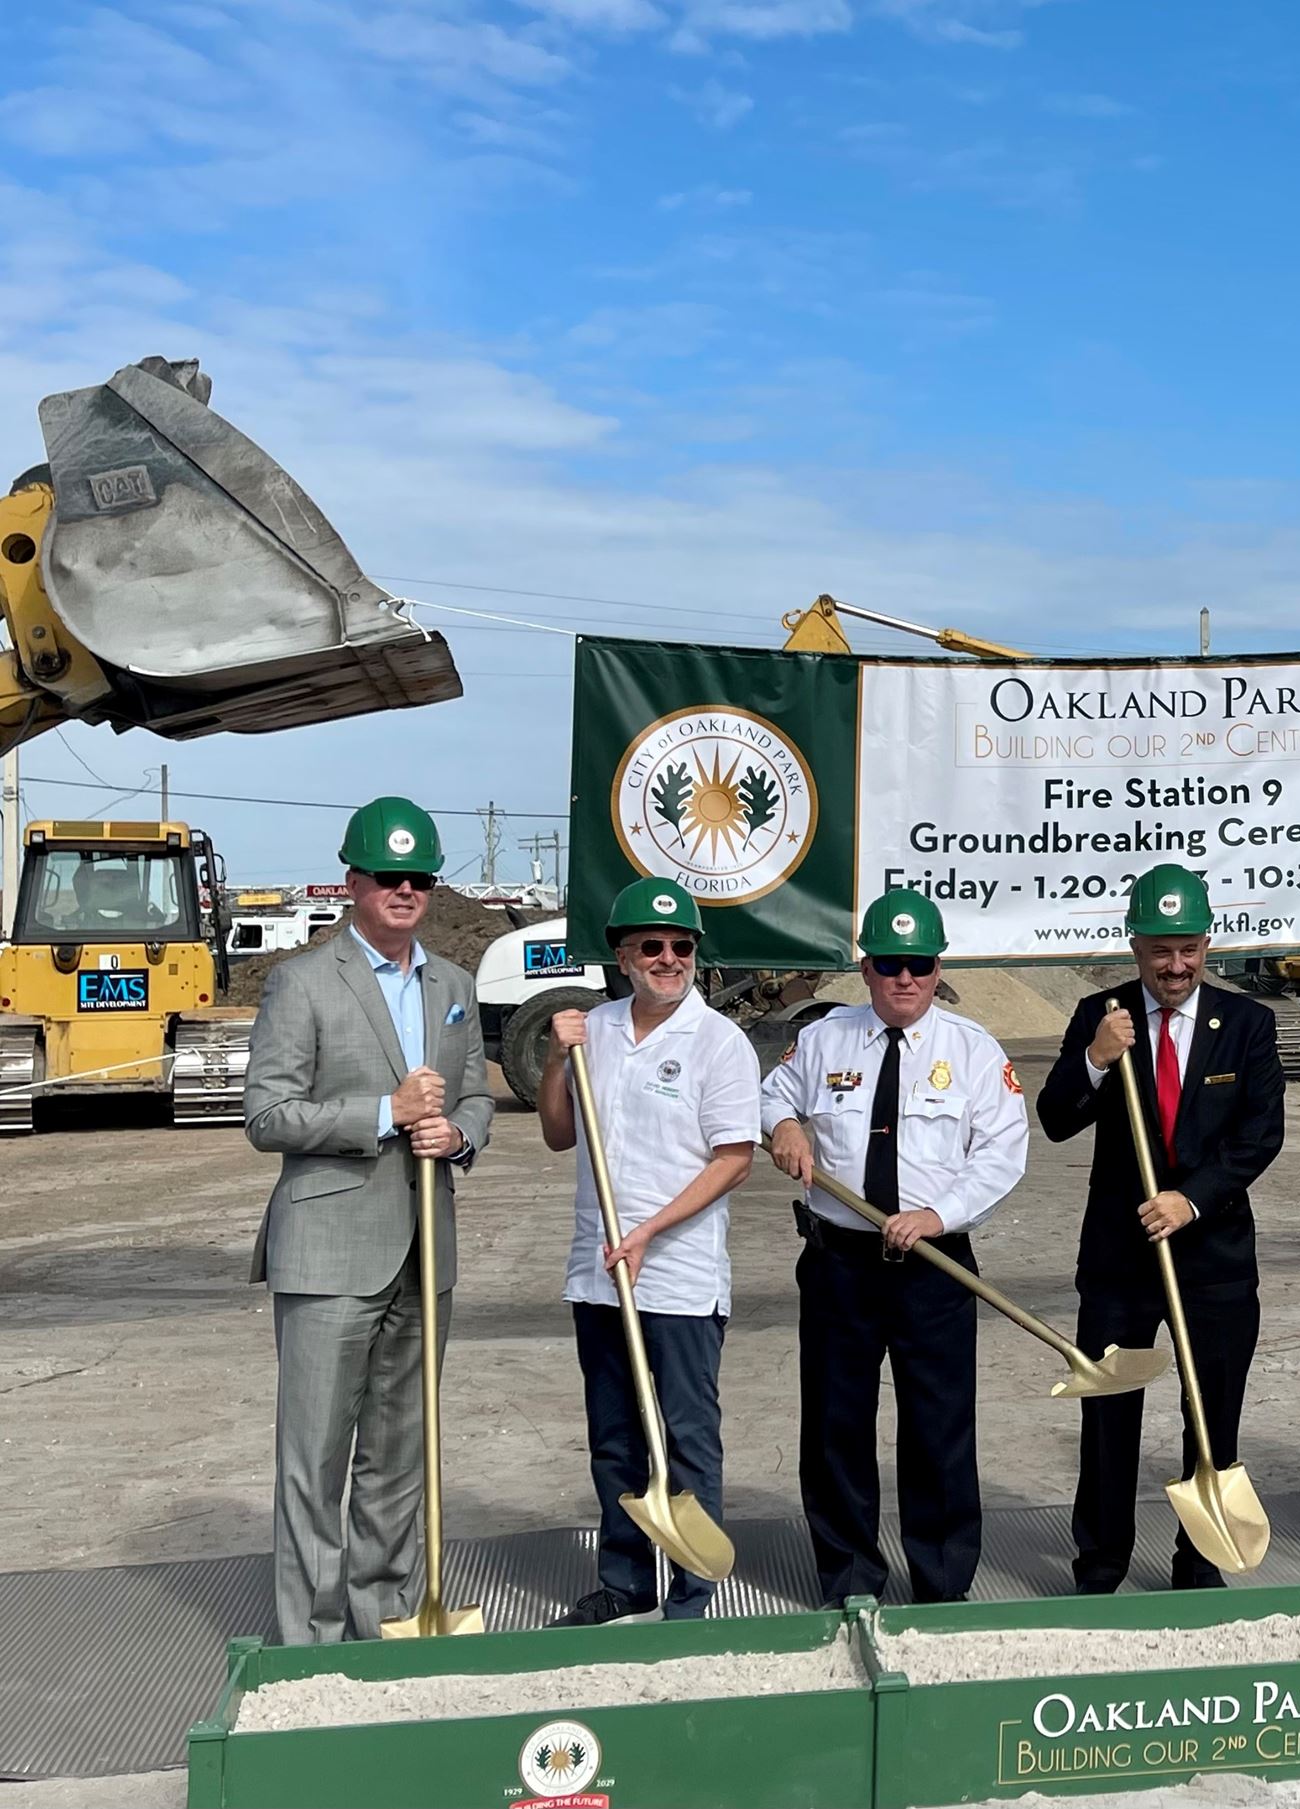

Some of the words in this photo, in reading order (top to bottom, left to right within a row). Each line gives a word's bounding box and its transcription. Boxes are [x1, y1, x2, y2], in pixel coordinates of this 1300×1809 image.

[96, 471, 144, 504] CAT
[990, 677, 1207, 722] OAKLAND
[628, 749, 655, 788] CITY
[658, 731, 674, 749] of
[679, 719, 772, 749] OAKLAND
[773, 750, 803, 796] PARK
[975, 725, 1094, 759] BUILDING
[1108, 734, 1166, 758] OUR
[1181, 733, 1216, 757] 2ND
[1045, 779, 1113, 809] Fire
[1124, 776, 1250, 808] Station
[1262, 779, 1282, 806] 9
[909, 820, 1207, 857] Groundbreaking
[312, 887, 349, 895] OAKLAN
[676, 871, 752, 892] FLORIDA
[884, 868, 999, 908] Friday
[1034, 869, 1209, 899] 1.20.2
[1034, 911, 1295, 941] www.oakrkfl.gov
[526, 944, 566, 969] EM
[80, 974, 145, 1001] EMS
[95, 1000, 146, 1009] DEVELOPMENT
[1032, 1693, 1241, 1738] OAKLAND
[1017, 1739, 1132, 1775] BUILDING
[1142, 1739, 1199, 1766] OUR
[1212, 1736, 1248, 1761] 2ND
[504, 1788, 523, 1796] 1929
[596, 1779, 616, 1788] 2029
[556, 1798, 571, 1806] THE
[572, 1797, 604, 1806] FUTURE
